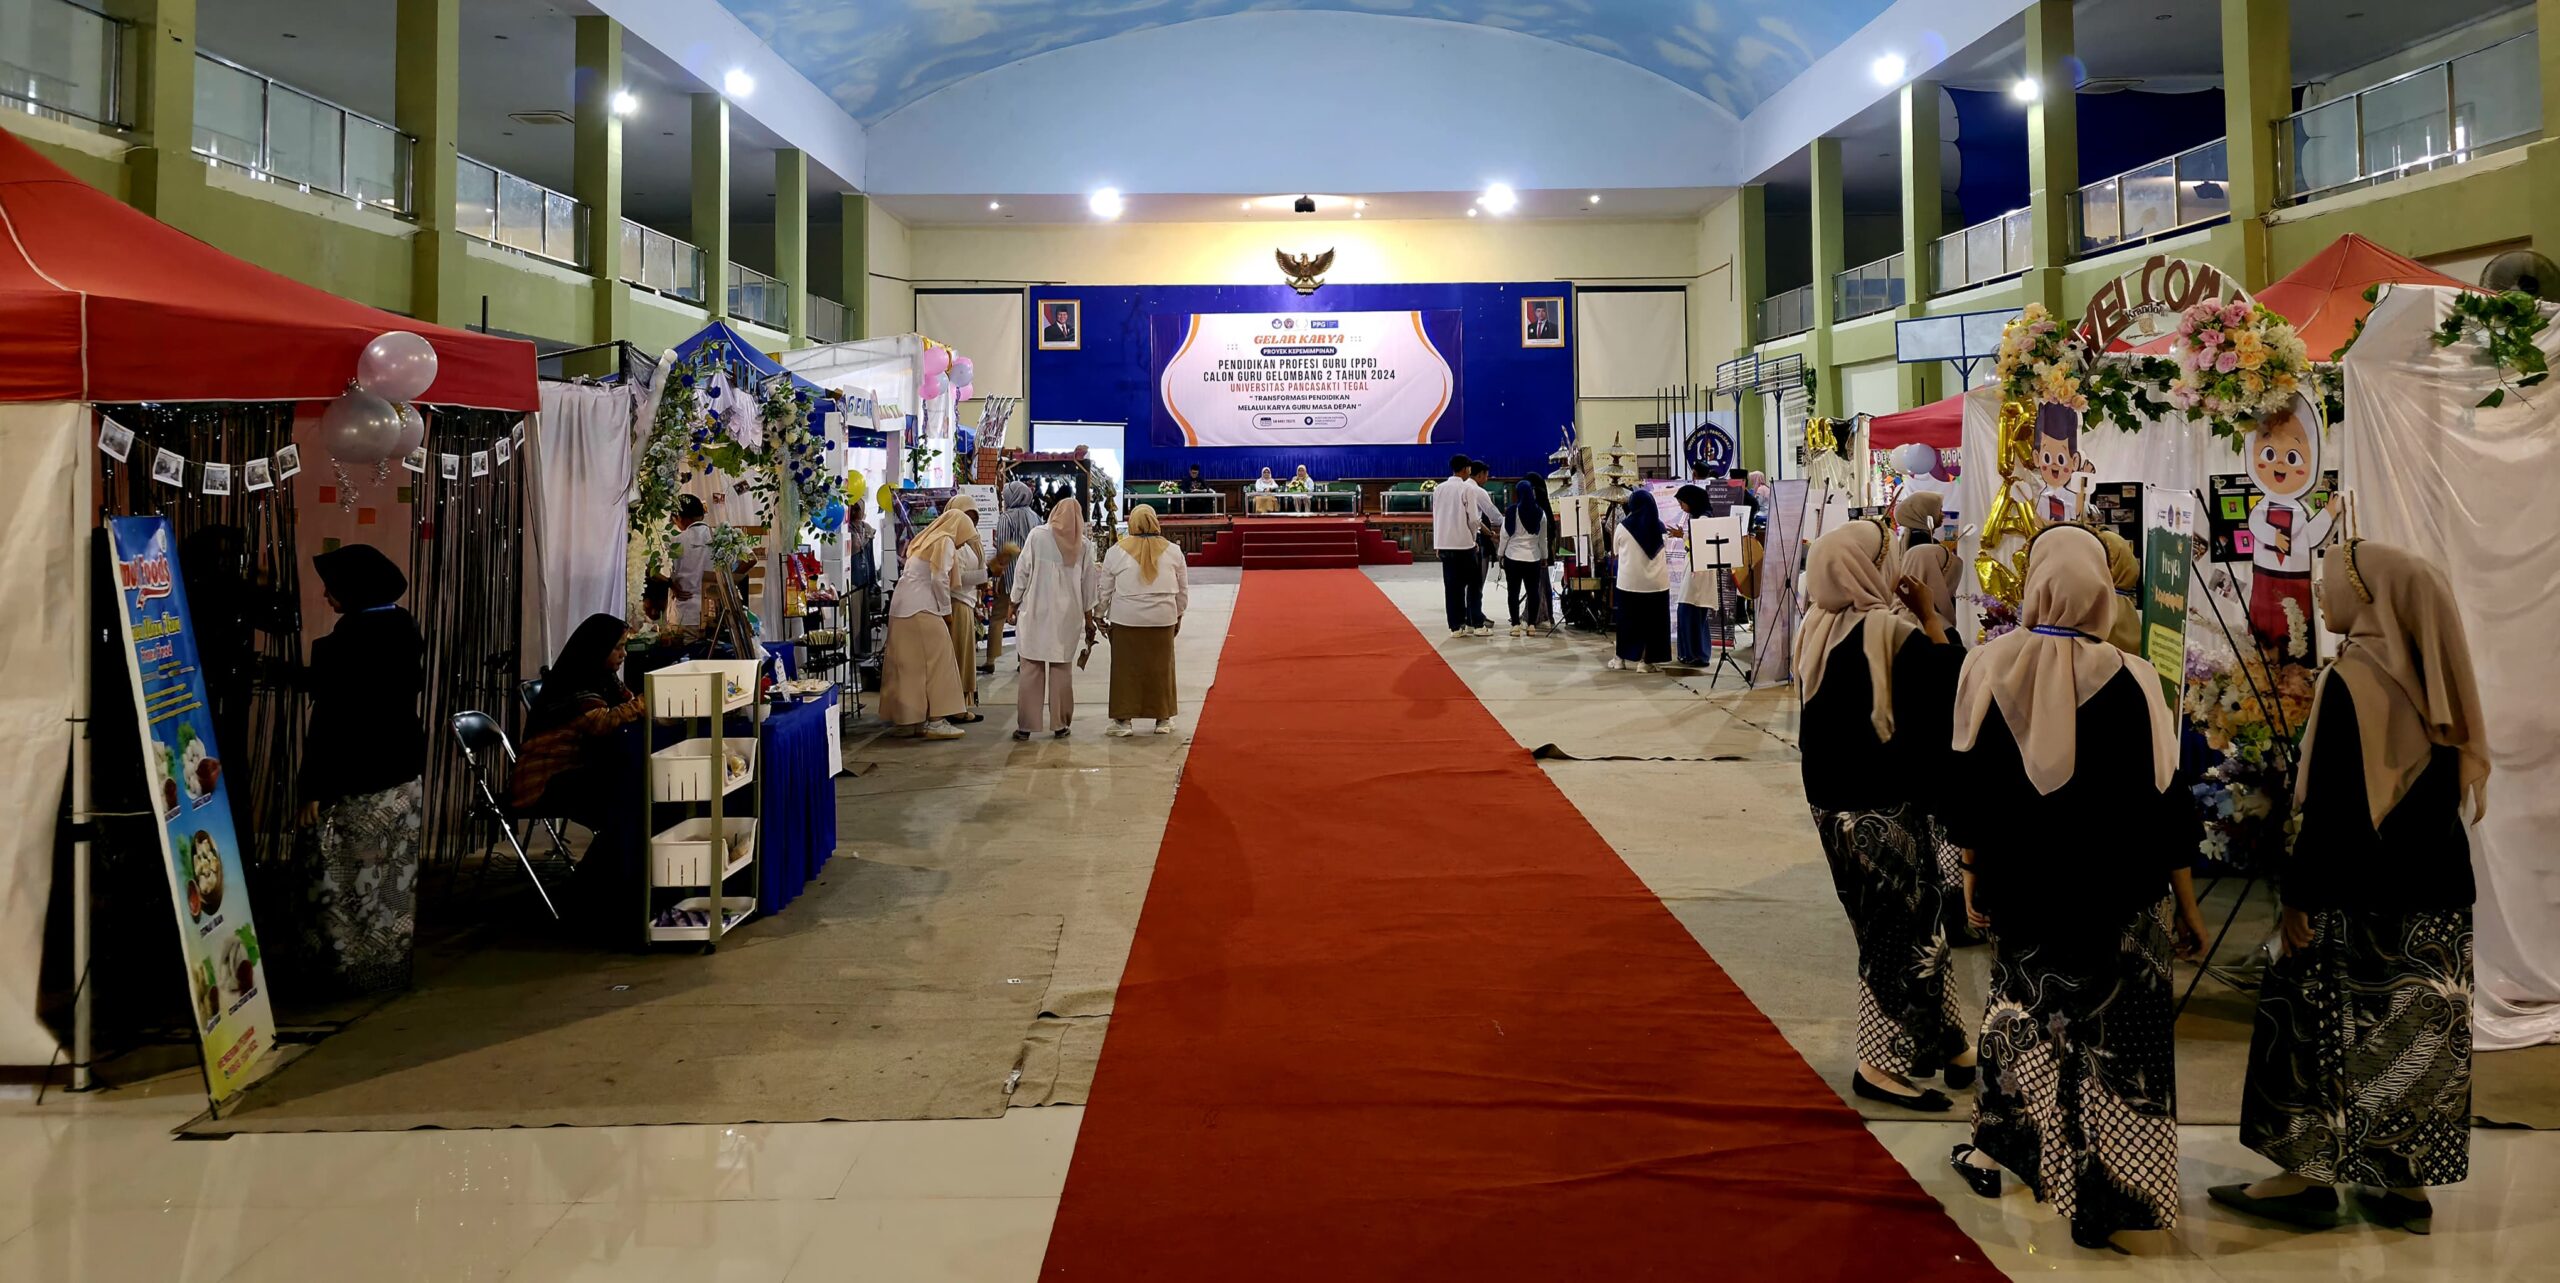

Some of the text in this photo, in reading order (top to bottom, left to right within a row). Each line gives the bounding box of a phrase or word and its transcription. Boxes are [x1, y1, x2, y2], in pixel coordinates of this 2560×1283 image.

[2074, 253, 2248, 358] WELCOM
[1253, 334, 1345, 344] GELAR KARYA
[1218, 358, 1377, 370] PENDIDIKAN PROFESI GURU (PPG)
[1203, 369, 1396, 382] CALON GURU GELOMBANG 2 TAHUN 2024
[1230, 381, 1369, 392] UNIVERSITAS PANCASAKTI TEGAL
